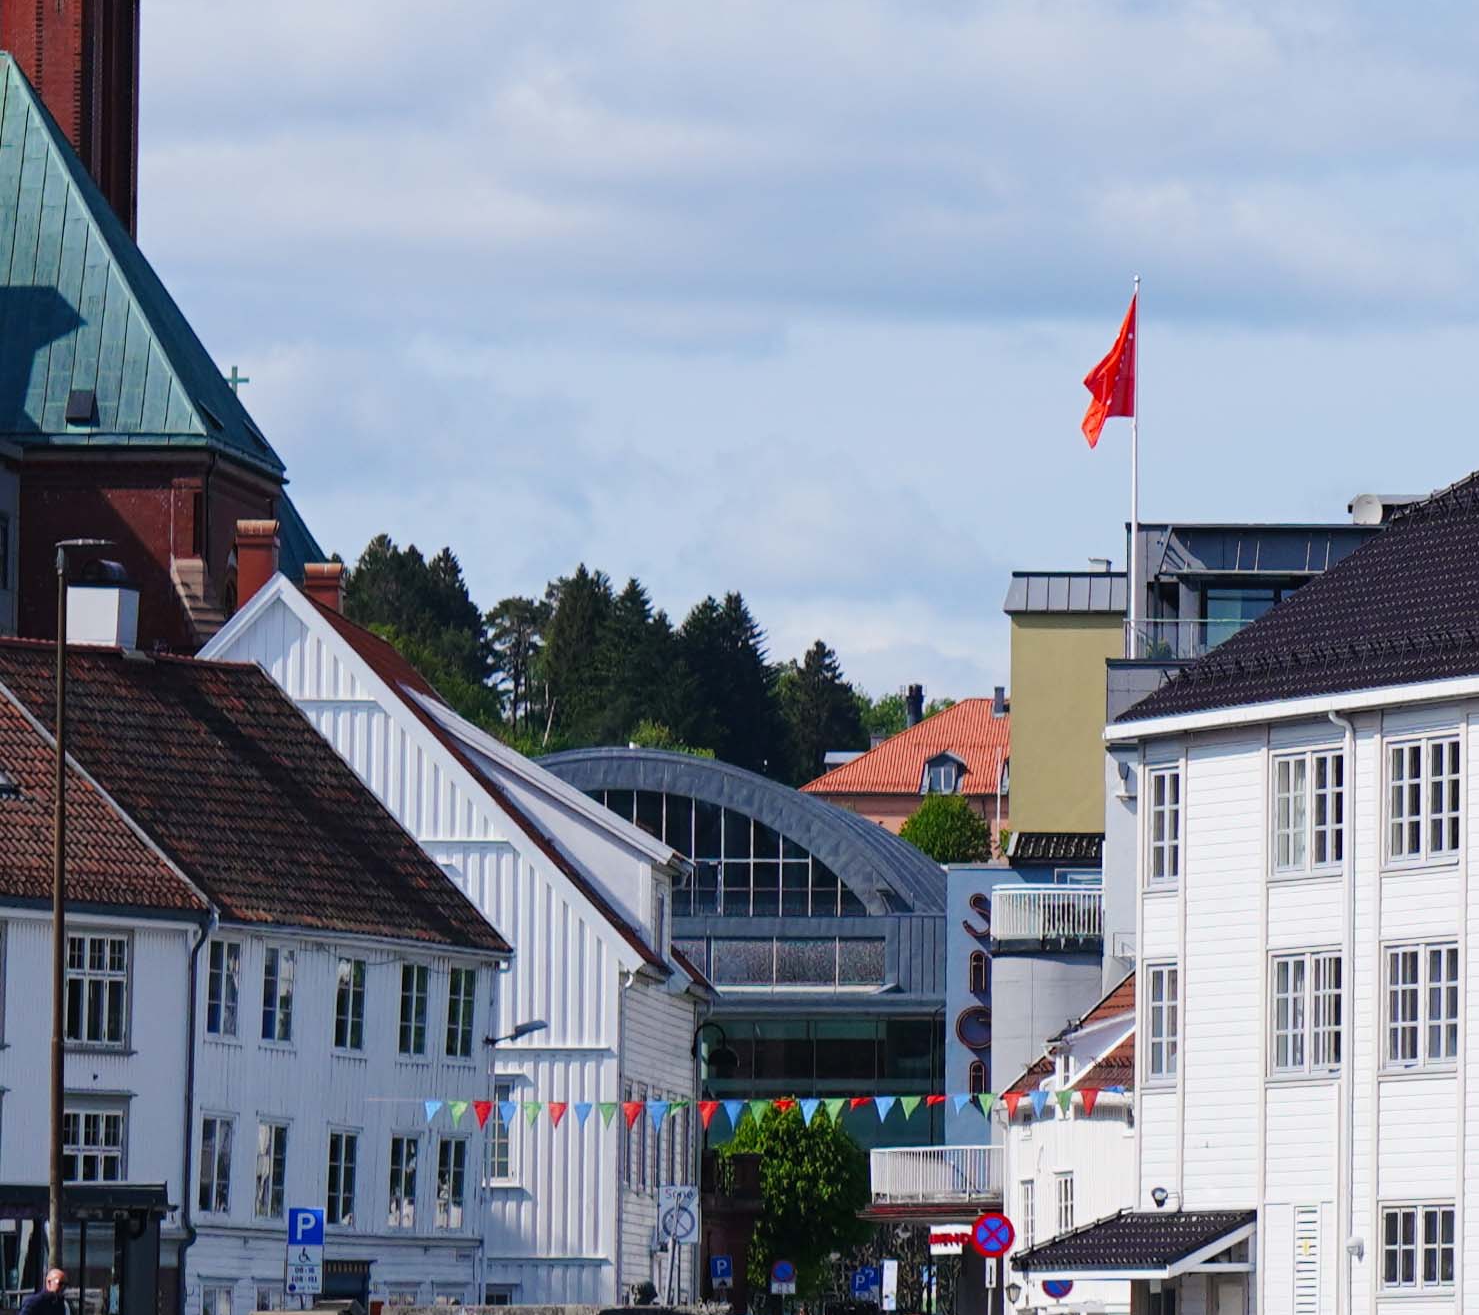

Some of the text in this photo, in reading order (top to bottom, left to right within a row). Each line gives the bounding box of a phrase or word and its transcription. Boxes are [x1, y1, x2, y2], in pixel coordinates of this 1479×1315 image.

[296, 1212, 317, 1241] P
[716, 1259, 728, 1276] P
[855, 1274, 866, 1289] P
